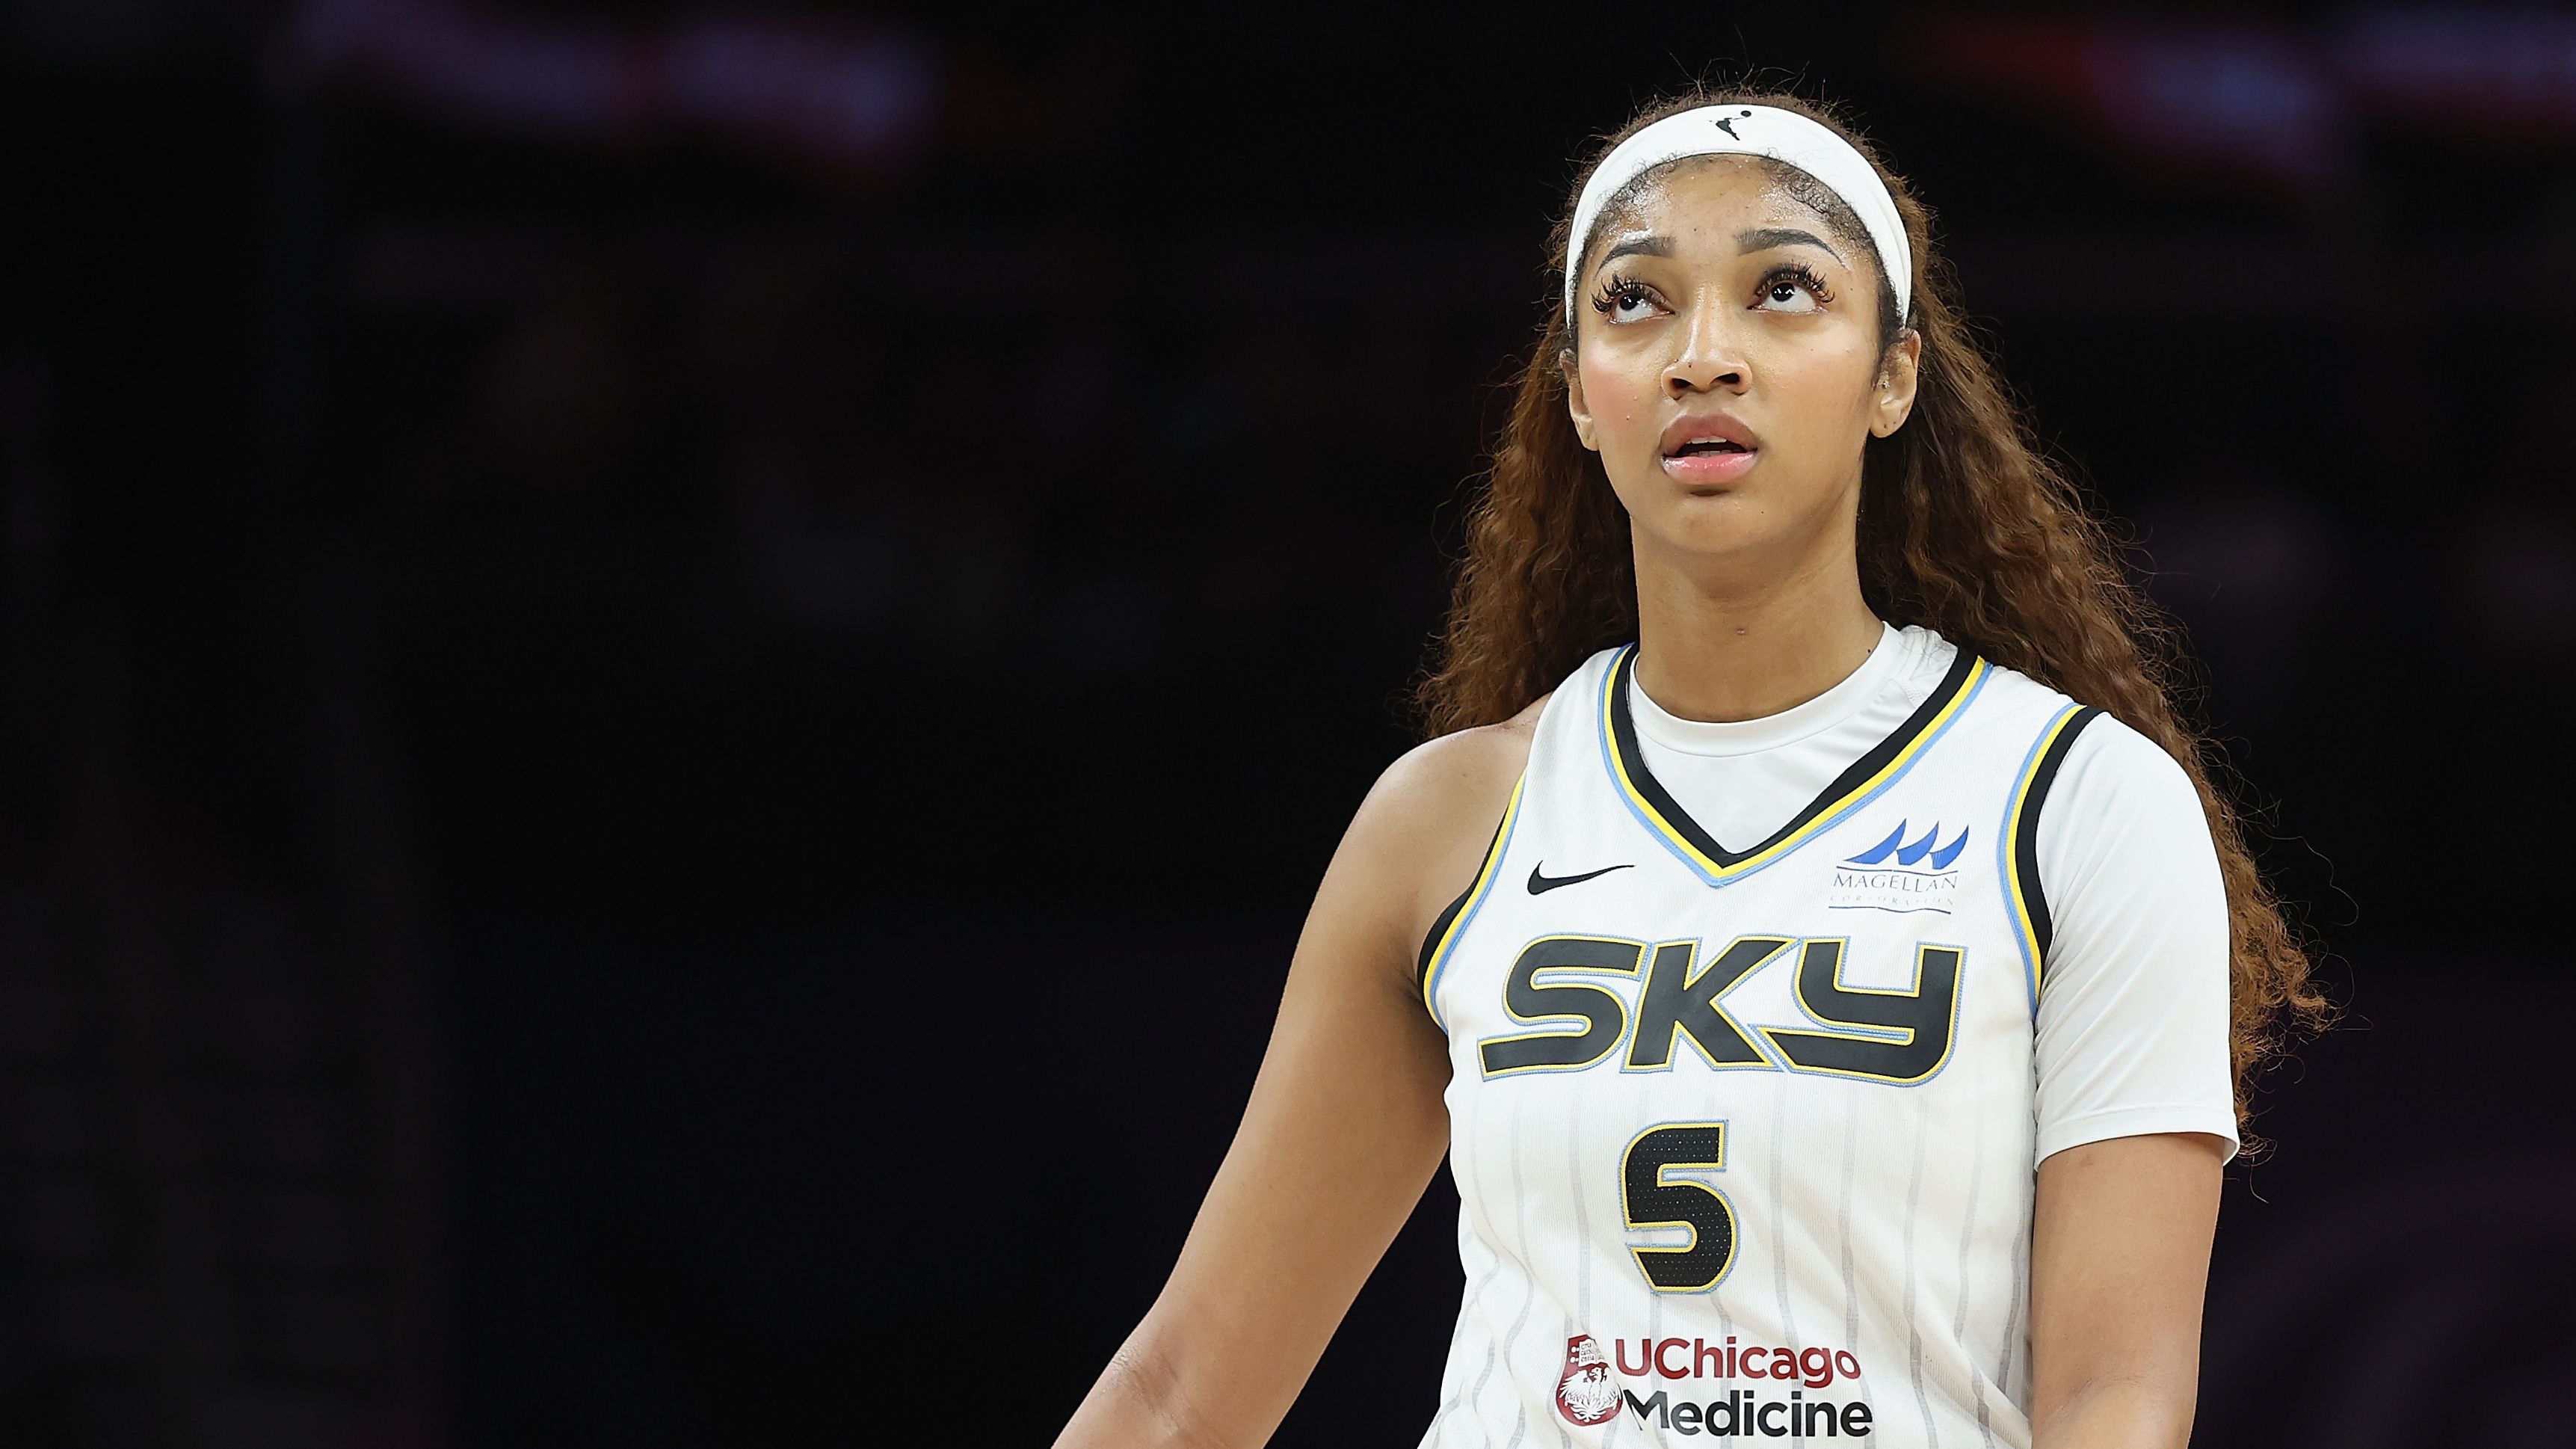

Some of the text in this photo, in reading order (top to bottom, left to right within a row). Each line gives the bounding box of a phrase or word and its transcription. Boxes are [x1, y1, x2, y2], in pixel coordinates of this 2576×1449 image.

[1833, 873, 1958, 893] MAGELLAN
[1477, 932, 1968, 1088] SKY
[1618, 1119, 1741, 1295] 5
[1615, 1335, 1862, 1389] UChicago
[1623, 1388, 1873, 1437] Medicine
